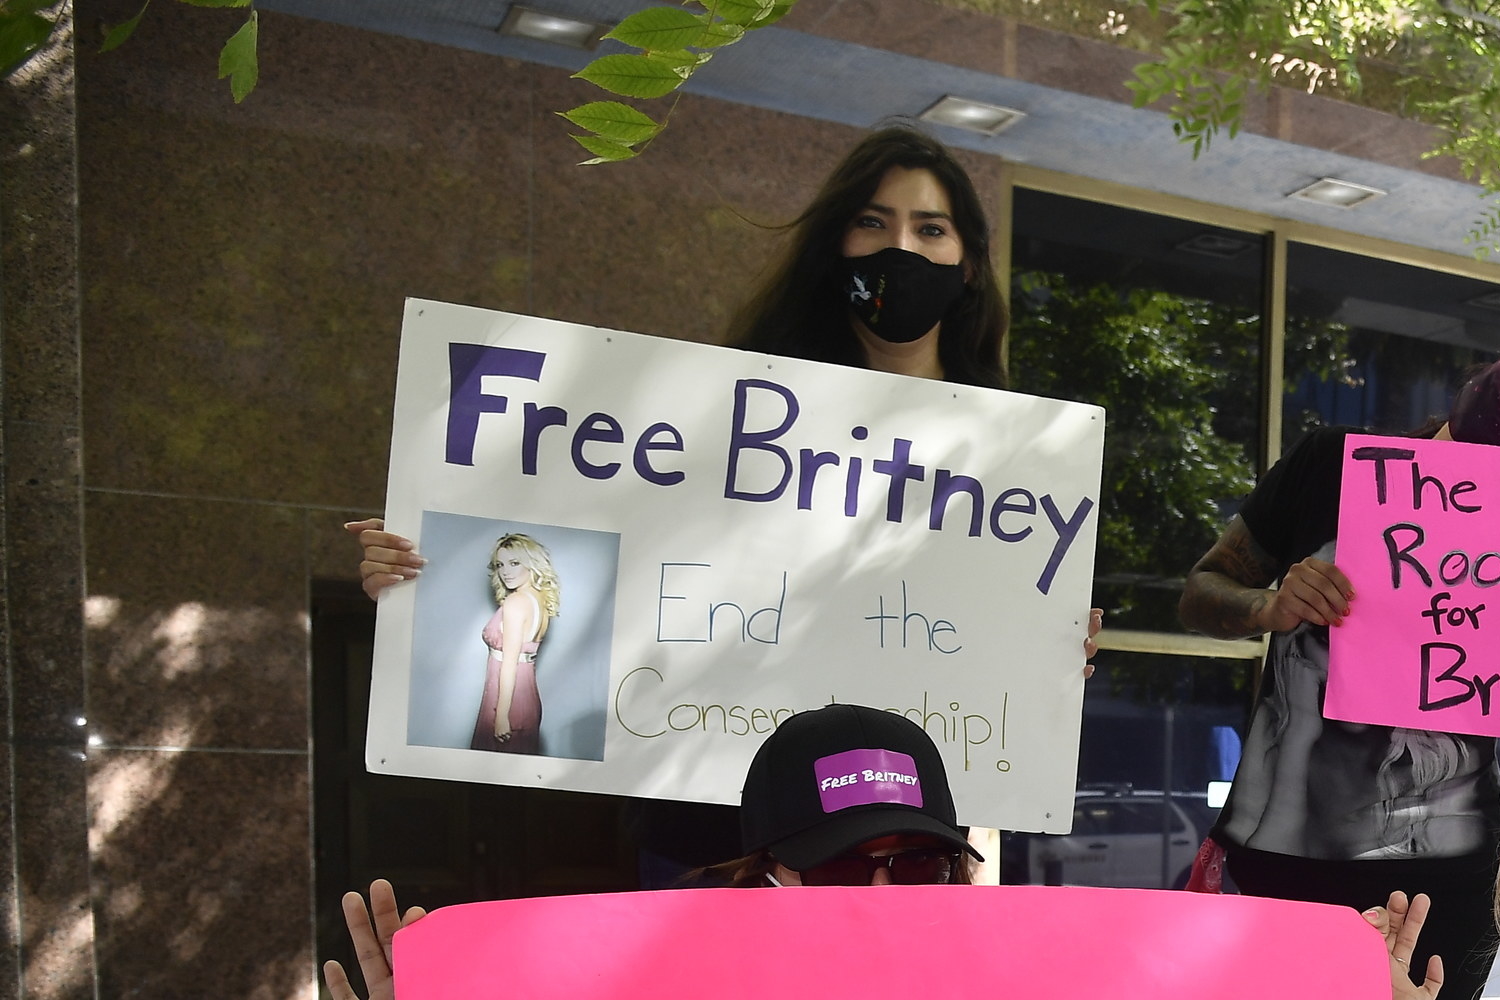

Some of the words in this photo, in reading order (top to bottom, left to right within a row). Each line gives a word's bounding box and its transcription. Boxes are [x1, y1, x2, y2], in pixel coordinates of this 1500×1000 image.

[444, 341, 686, 487] Free
[723, 378, 1095, 596] Britney
[1351, 446, 1483, 514] The
[656, 562, 788, 645] End
[864, 580, 963, 655] the
[1421, 591, 1487, 636] for
[820, 773, 858, 792] FREE
[861, 769, 918, 786] BRITNEY
